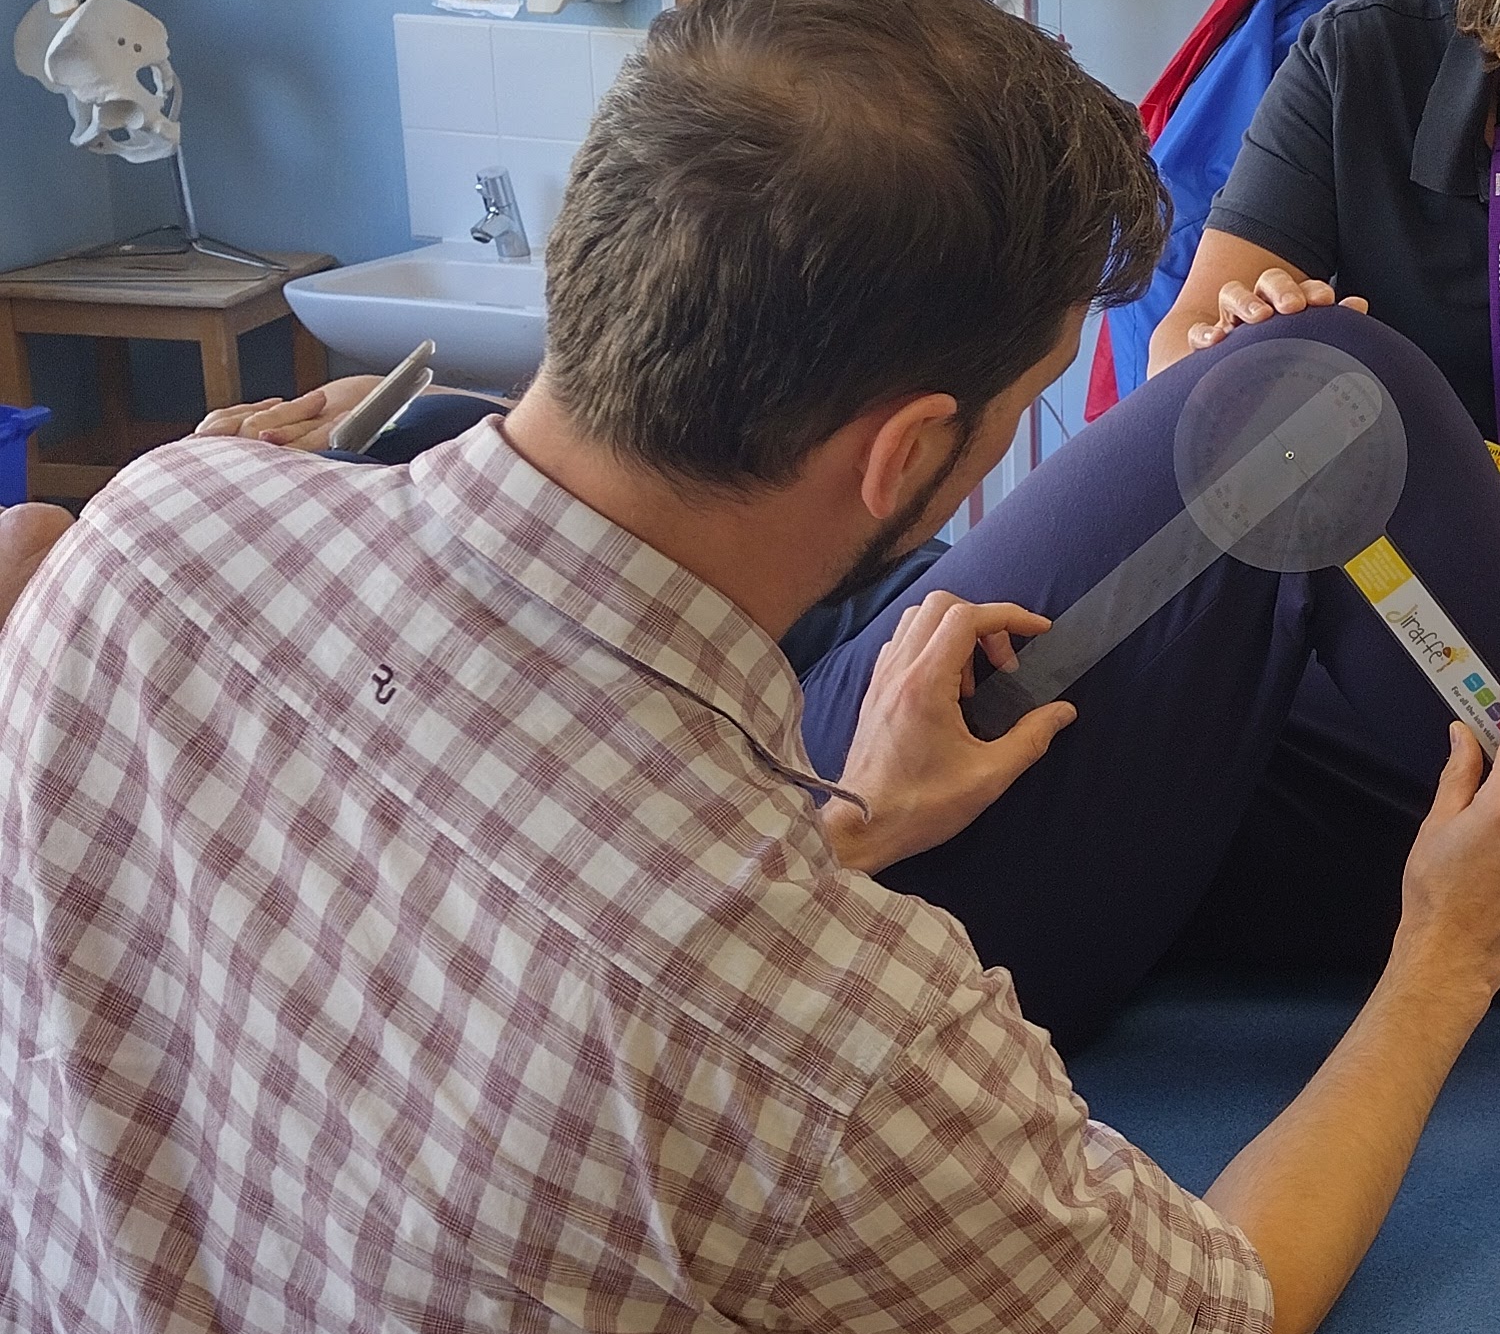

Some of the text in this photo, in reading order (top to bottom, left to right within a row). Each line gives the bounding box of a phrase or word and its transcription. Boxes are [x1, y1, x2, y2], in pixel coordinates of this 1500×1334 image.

[1452, 686, 1495, 740] For all the info visit
